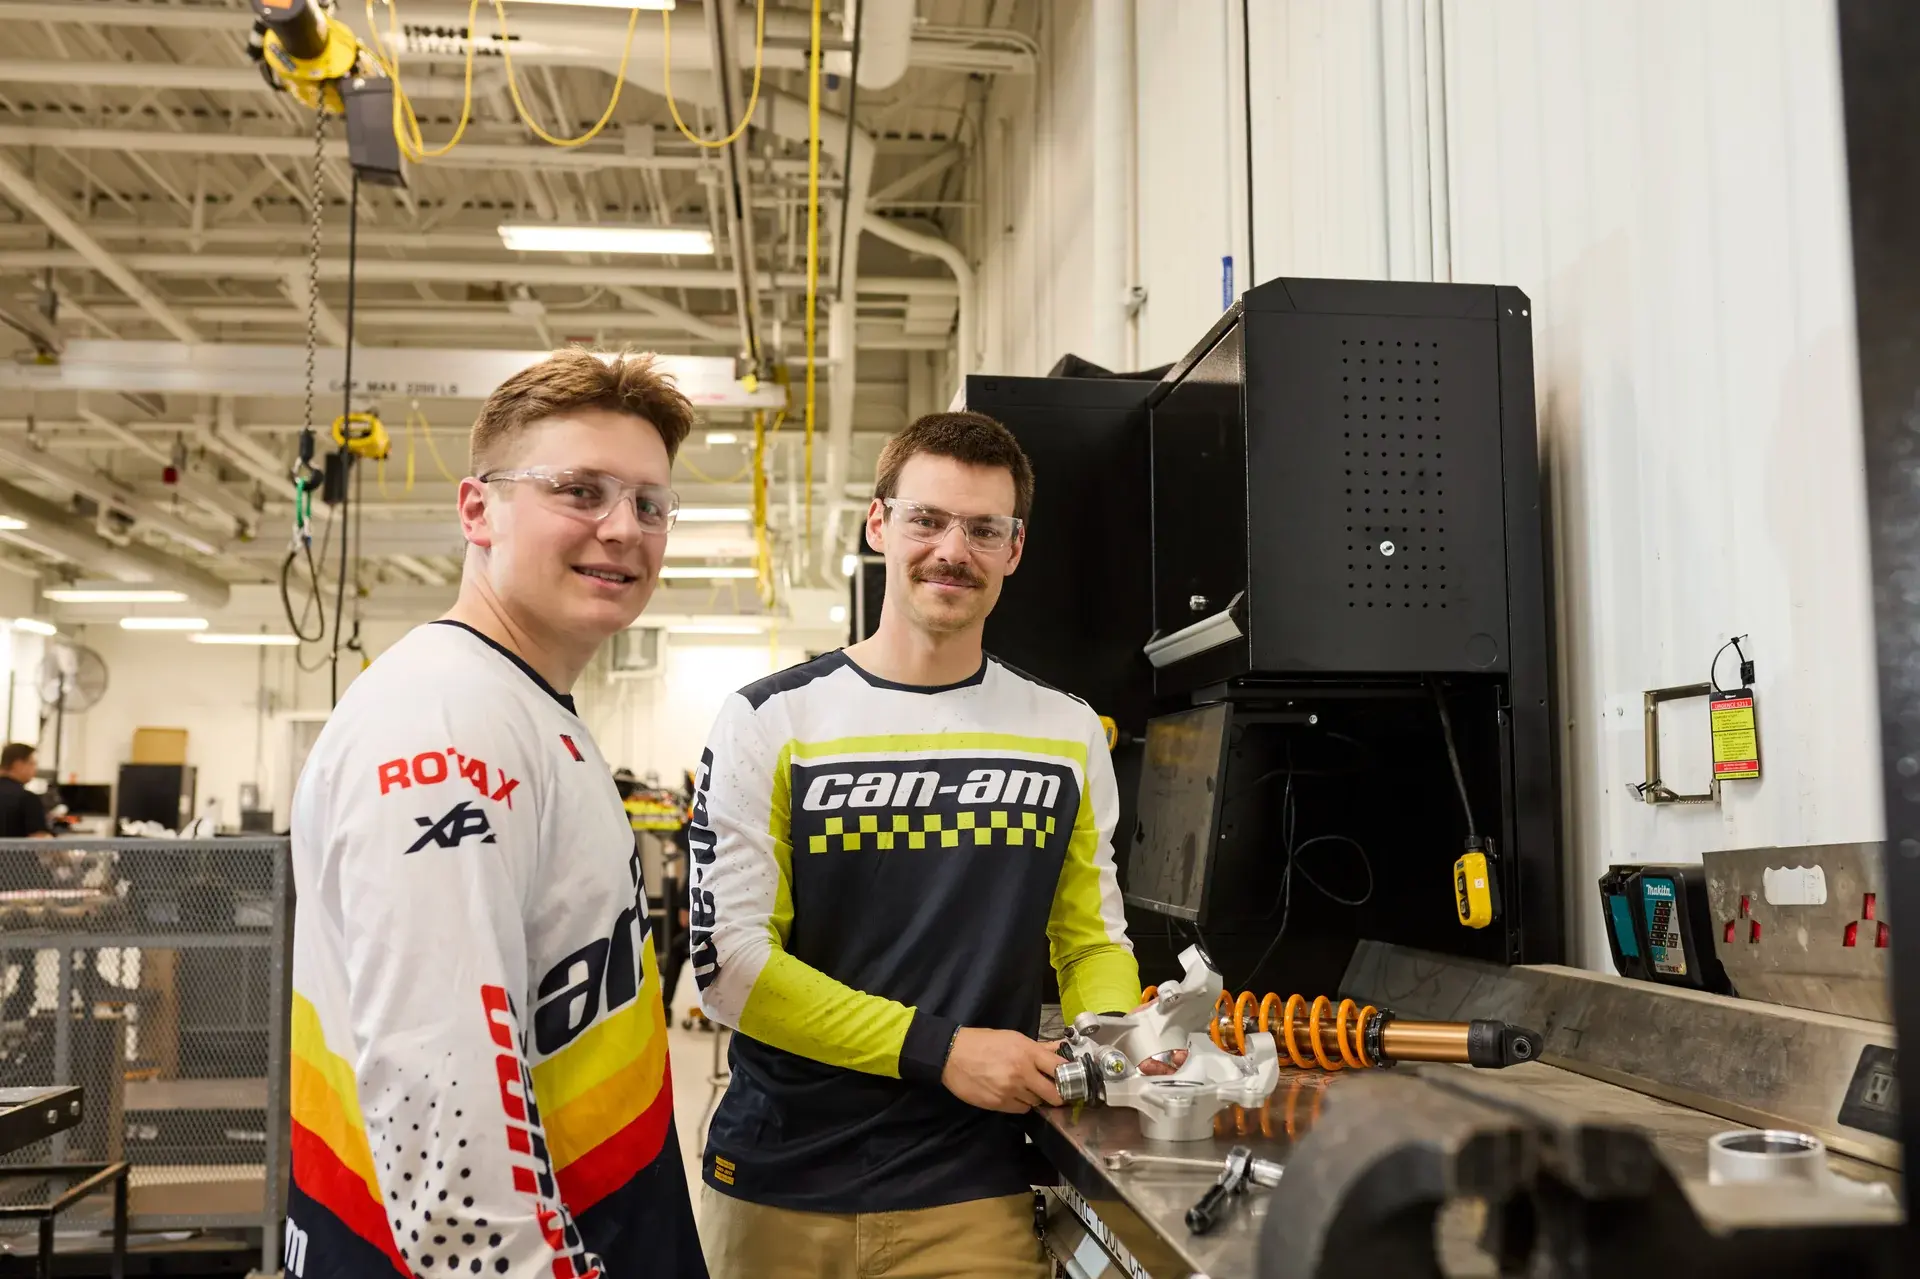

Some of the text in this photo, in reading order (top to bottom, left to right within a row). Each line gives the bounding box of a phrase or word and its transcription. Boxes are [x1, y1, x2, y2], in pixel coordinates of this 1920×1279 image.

[367, 381, 396, 393] MAX
[378, 747, 520, 811] ROTAX
[802, 769, 1061, 811] can-am
[1646, 883, 1672, 897] Makita
[1096, 1216, 1122, 1260] TOOL
